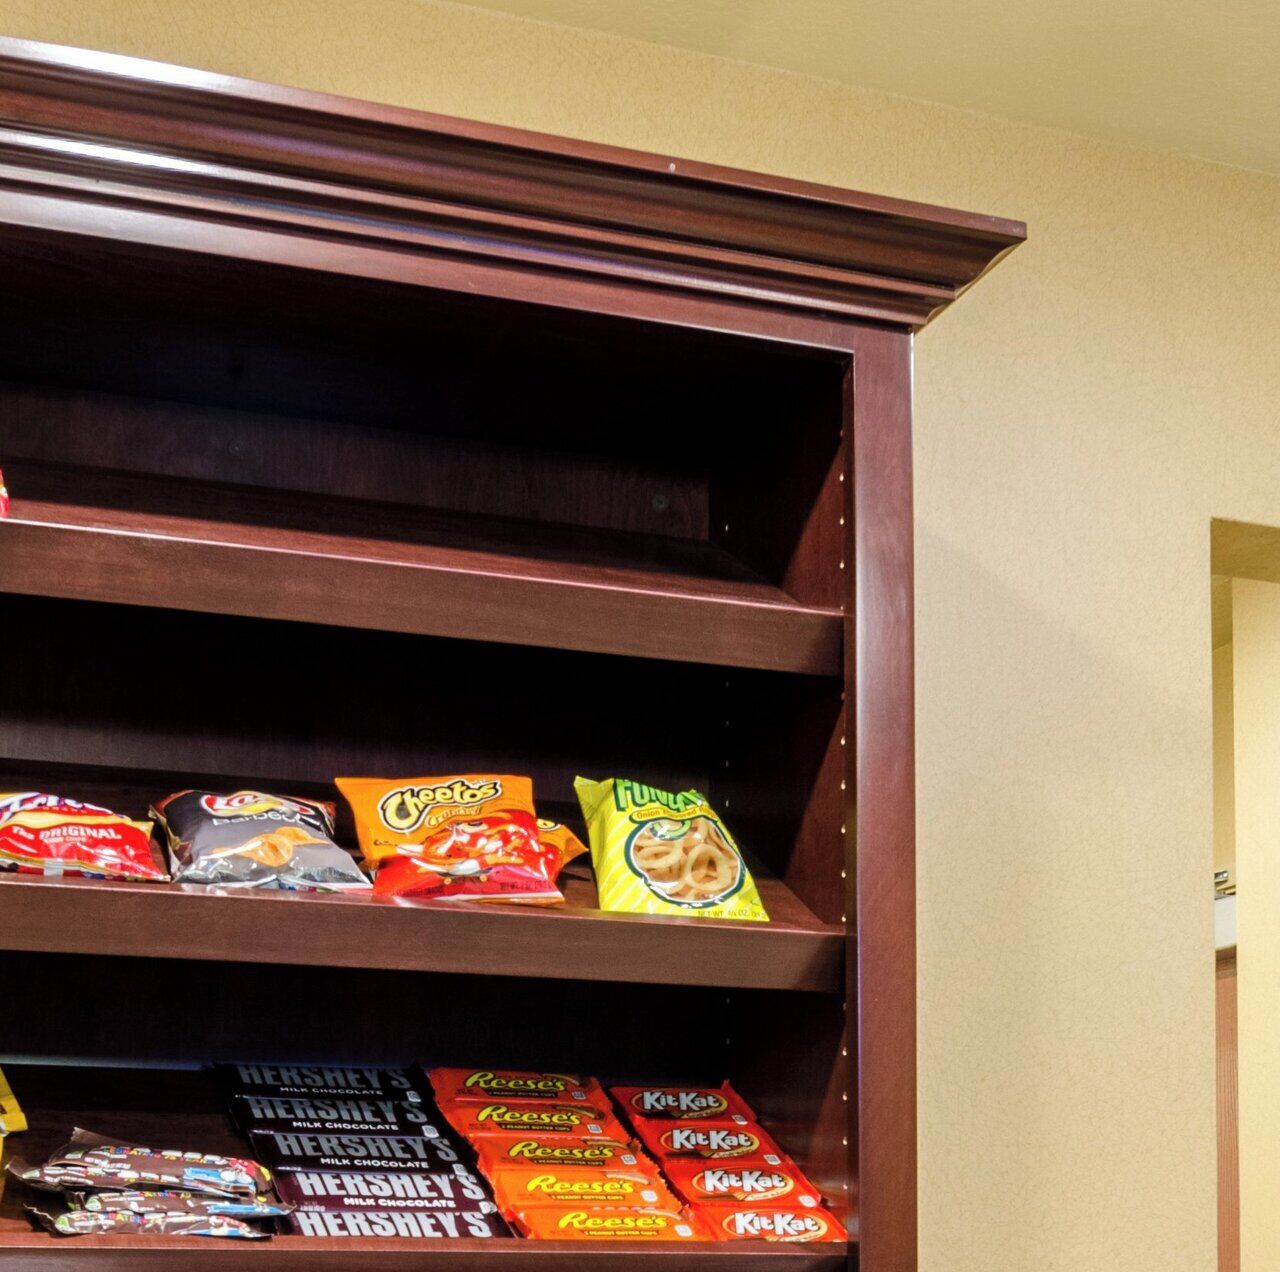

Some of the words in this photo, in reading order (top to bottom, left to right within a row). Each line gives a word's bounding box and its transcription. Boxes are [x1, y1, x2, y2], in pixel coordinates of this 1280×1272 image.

[379, 779, 503, 833] Cheetos
[11, 826, 34, 841] The
[38, 826, 122, 840] ORIGINAL
[237, 1064, 412, 1090] HERSHEY'S
[466, 1072, 566, 1092] Reese's
[280, 1086, 310, 1094] MILK
[312, 1088, 384, 1096] CHOCOLATE
[643, 1091, 678, 1110] Kit
[679, 1092, 719, 1111] Kat
[246, 1099, 429, 1124] HERSHEY'S
[477, 1105, 581, 1126] Reese's
[292, 1121, 323, 1130] MILK
[325, 1122, 400, 1132] CHOCOLATE
[274, 1133, 459, 1163] HERSHEY'S
[672, 1129, 708, 1149] Kit
[709, 1130, 751, 1150] Kat
[509, 1141, 614, 1160] Reese's
[320, 1157, 352, 1166] MILK
[353, 1158, 430, 1170] CHOCOLATE
[295, 1173, 487, 1201] HERSHEY'S
[526, 1175, 634, 1194] Reese's
[704, 1170, 741, 1192] Kit
[742, 1171, 786, 1192] Kat
[343, 1197, 377, 1207] MILK
[378, 1198, 457, 1209] CHOCOLATE
[296, 1211, 493, 1239] HERSHEY'S
[558, 1211, 668, 1230] Reese's
[734, 1212, 773, 1235] Kit
[774, 1213, 819, 1235] Kat
